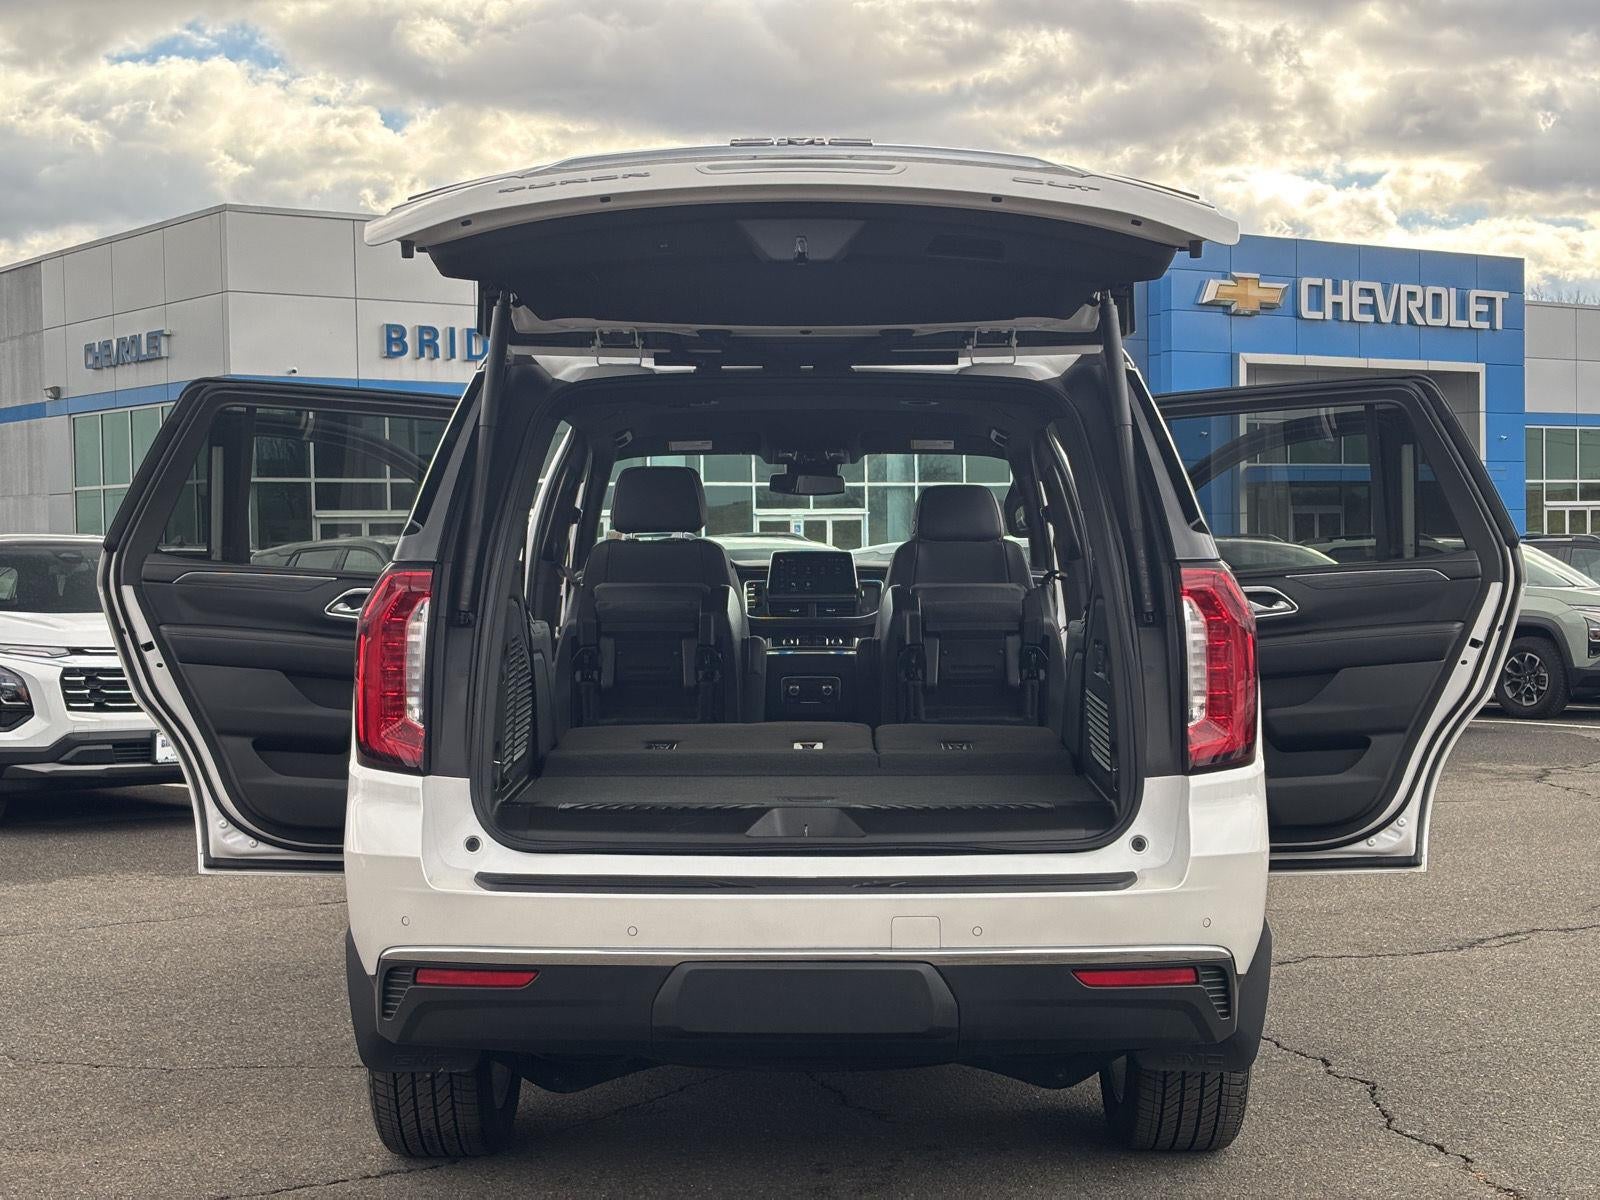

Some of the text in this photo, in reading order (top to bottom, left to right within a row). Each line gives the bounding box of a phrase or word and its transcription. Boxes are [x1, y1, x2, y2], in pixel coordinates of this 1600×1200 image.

[1300, 277, 1510, 330] CHEVROLET
[84, 329, 170, 370] CHEVROLET
[382, 323, 489, 361] BRID
